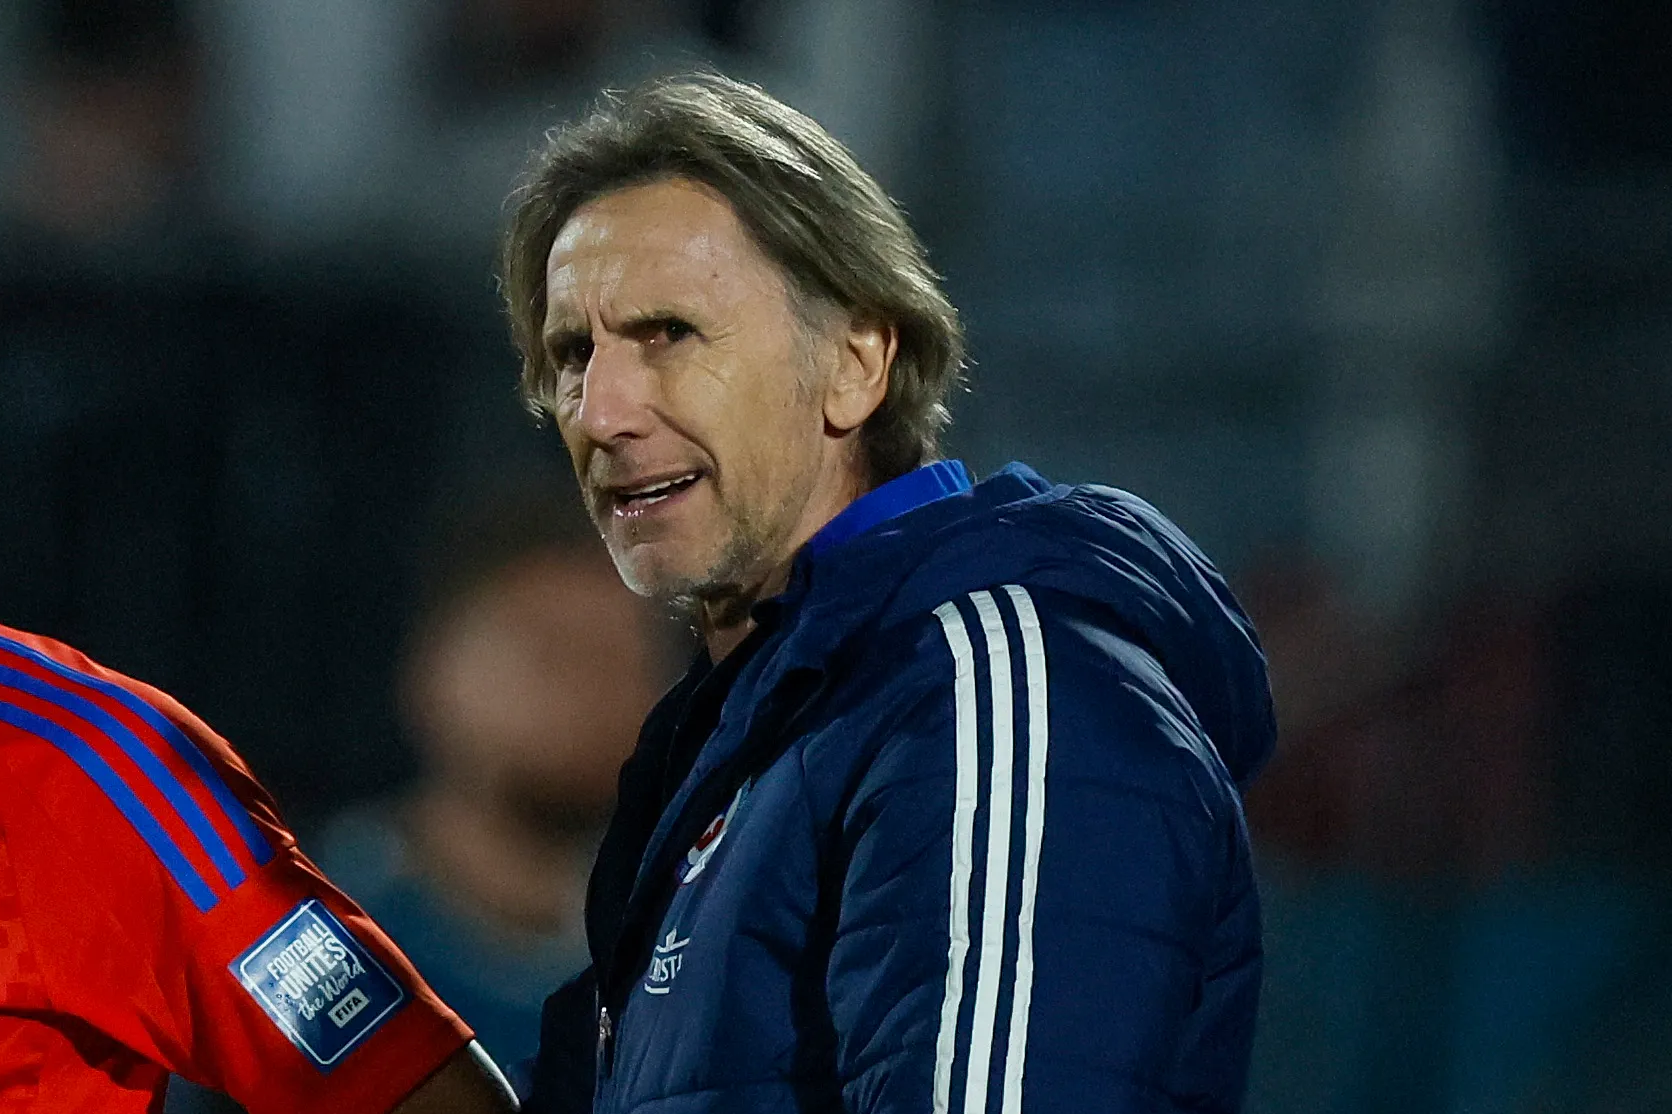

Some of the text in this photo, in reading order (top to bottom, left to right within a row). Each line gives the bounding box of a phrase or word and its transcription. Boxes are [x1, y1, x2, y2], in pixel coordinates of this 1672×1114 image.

[266, 922, 329, 981] FOOTBALL
[278, 936, 347, 1000] UNITES
[335, 995, 363, 1021] FIFA
